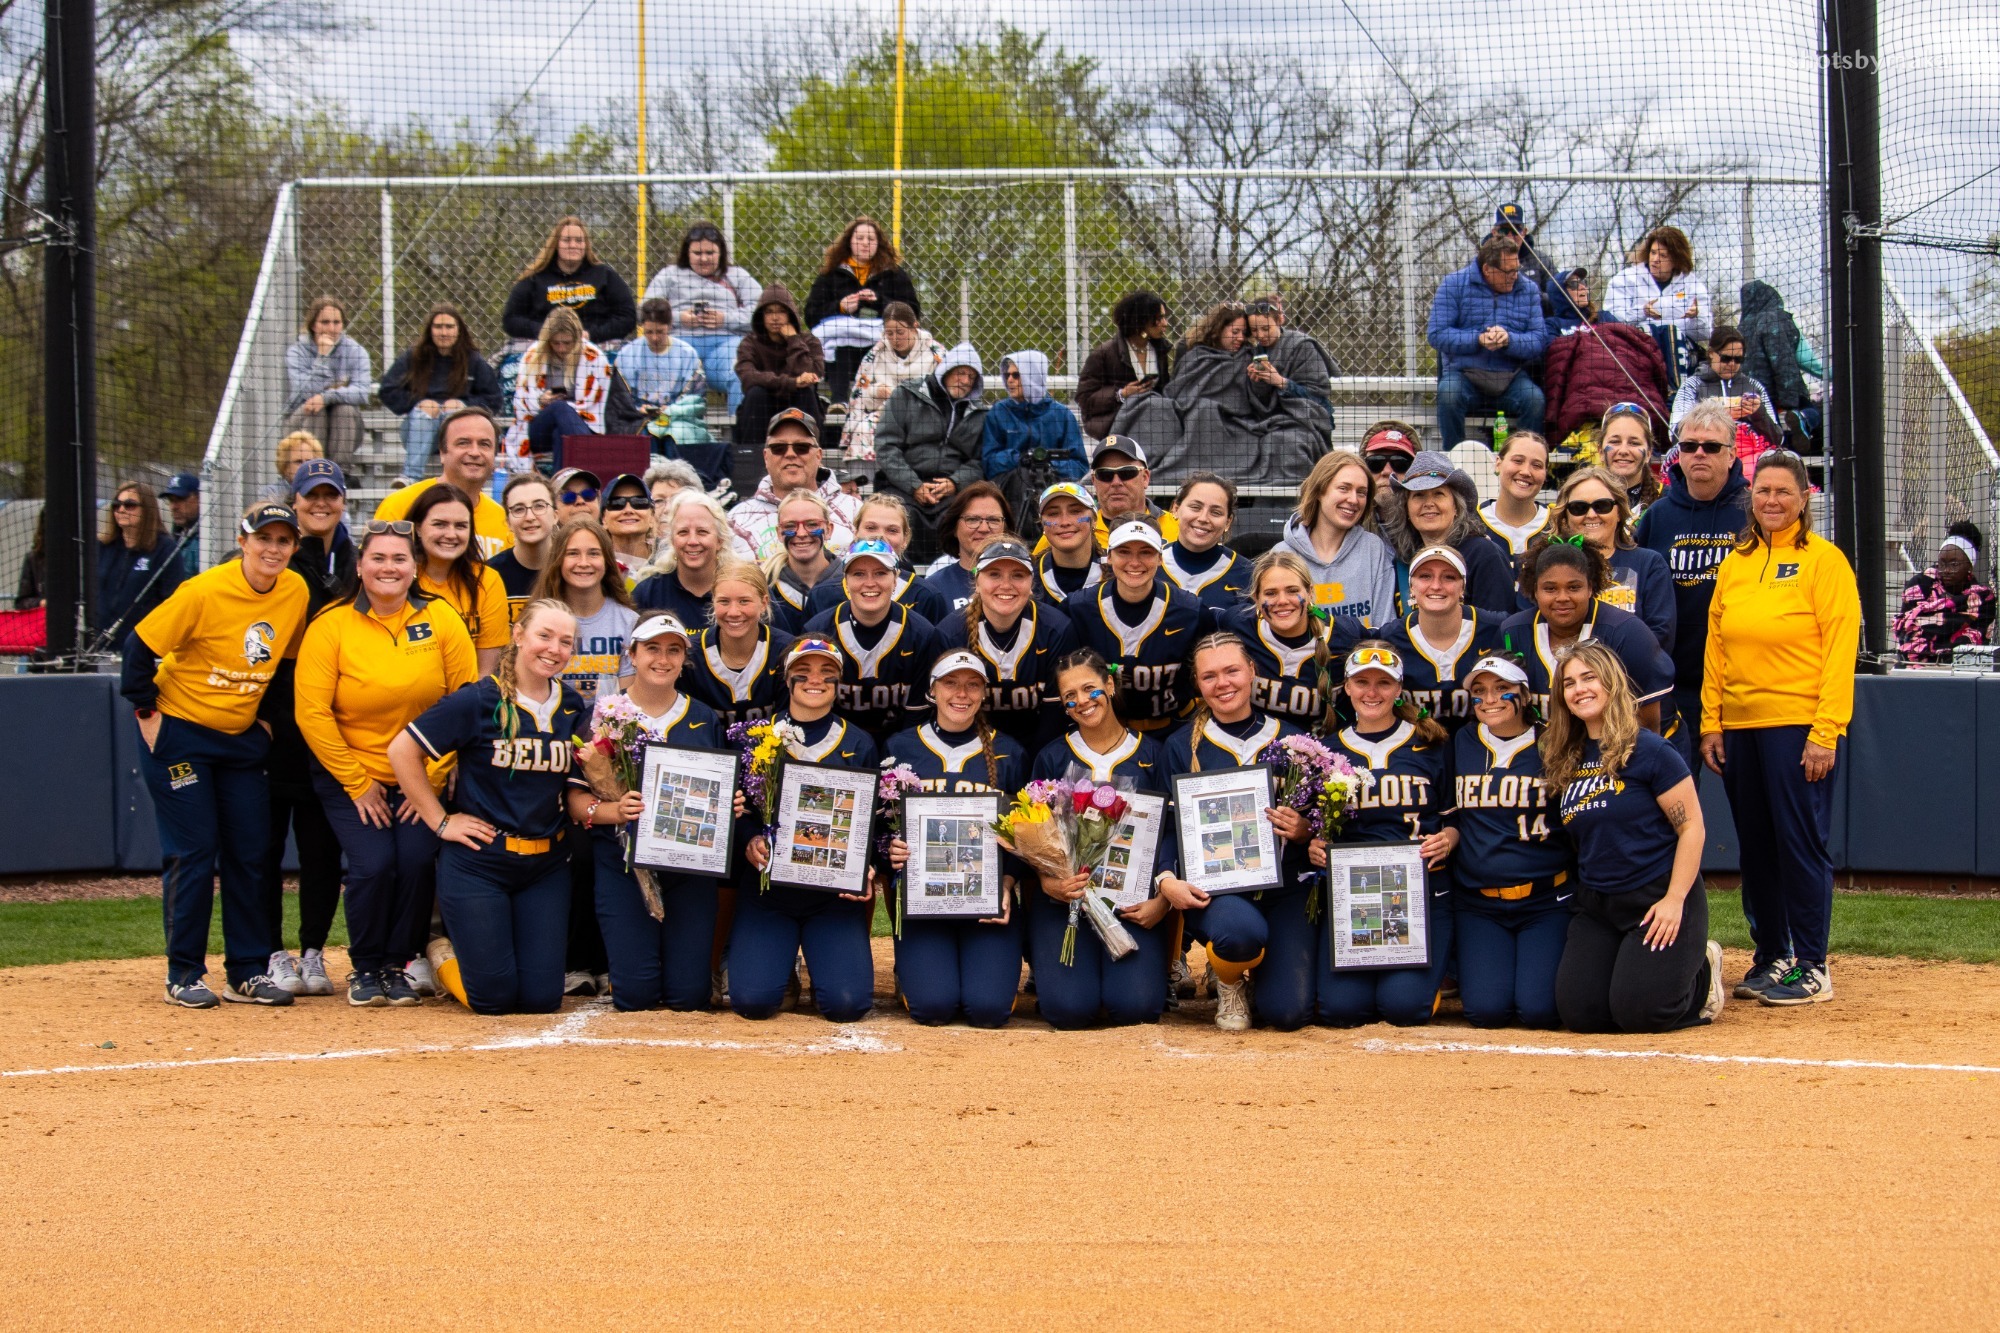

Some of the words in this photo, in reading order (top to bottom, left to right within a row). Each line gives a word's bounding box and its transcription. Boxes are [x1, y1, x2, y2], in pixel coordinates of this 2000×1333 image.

[1775, 563, 1800, 579] B
[1313, 581, 1345, 605] B
[405, 622, 433, 643] B
[837, 682, 911, 711] ELOIT
[1151, 688, 1179, 717] 12
[1455, 774, 1547, 809] BELOIT
[1403, 812, 1420, 840] 7
[1517, 813, 1550, 842] 14
